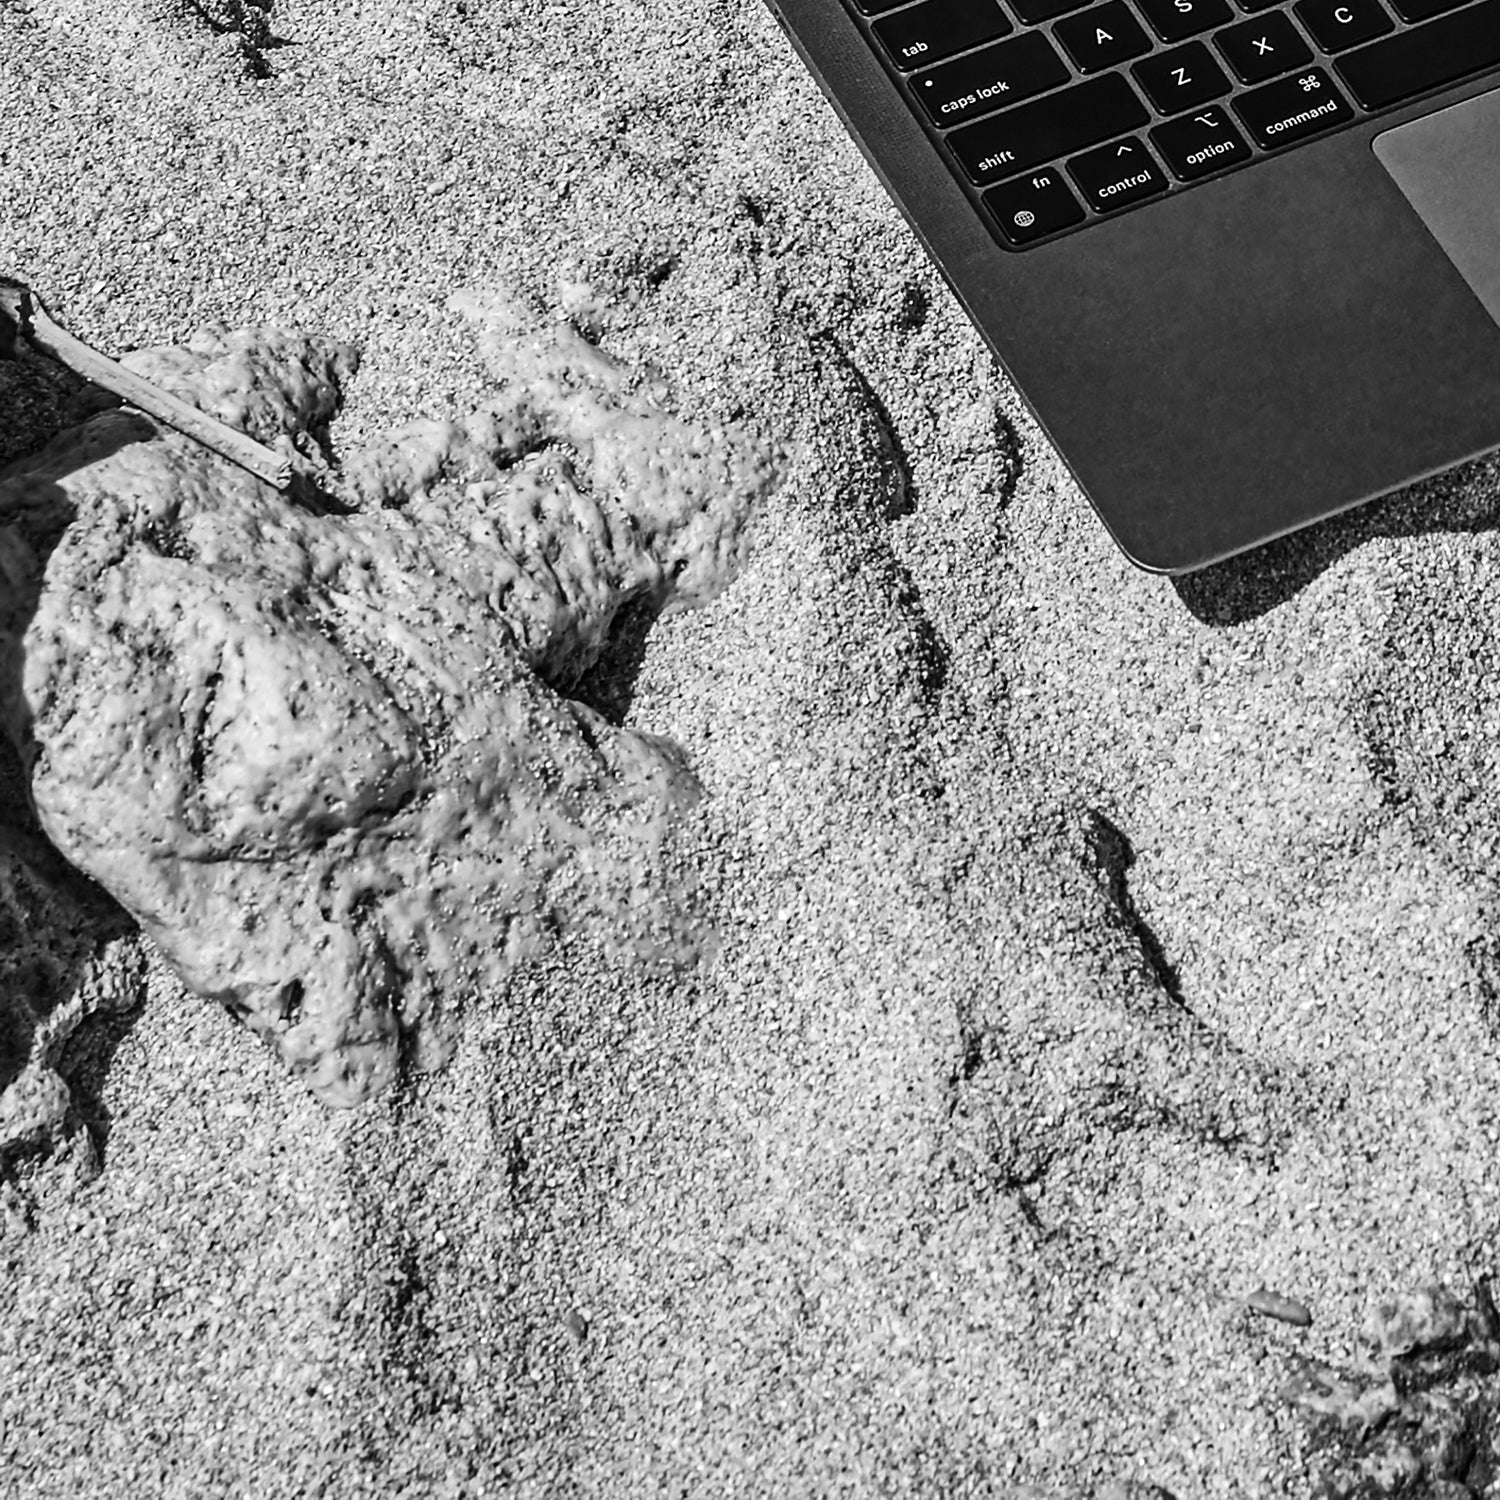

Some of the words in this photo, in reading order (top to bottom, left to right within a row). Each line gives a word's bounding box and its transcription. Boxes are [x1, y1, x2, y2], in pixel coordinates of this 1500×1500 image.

[1334, 7, 1354, 24] C
[1095, 28, 1114, 45] A
[1251, 36, 1274, 56] X
[901, 41, 929, 57] tab
[1170, 67, 1192, 86] Z
[940, 94, 977, 113] caps
[976, 81, 1010, 101] lock
[1265, 99, 1338, 135] command
[978, 150, 1015, 171] shift
[1186, 141, 1235, 165] option
[1031, 174, 1051, 190] fn
[1098, 169, 1152, 198] control
